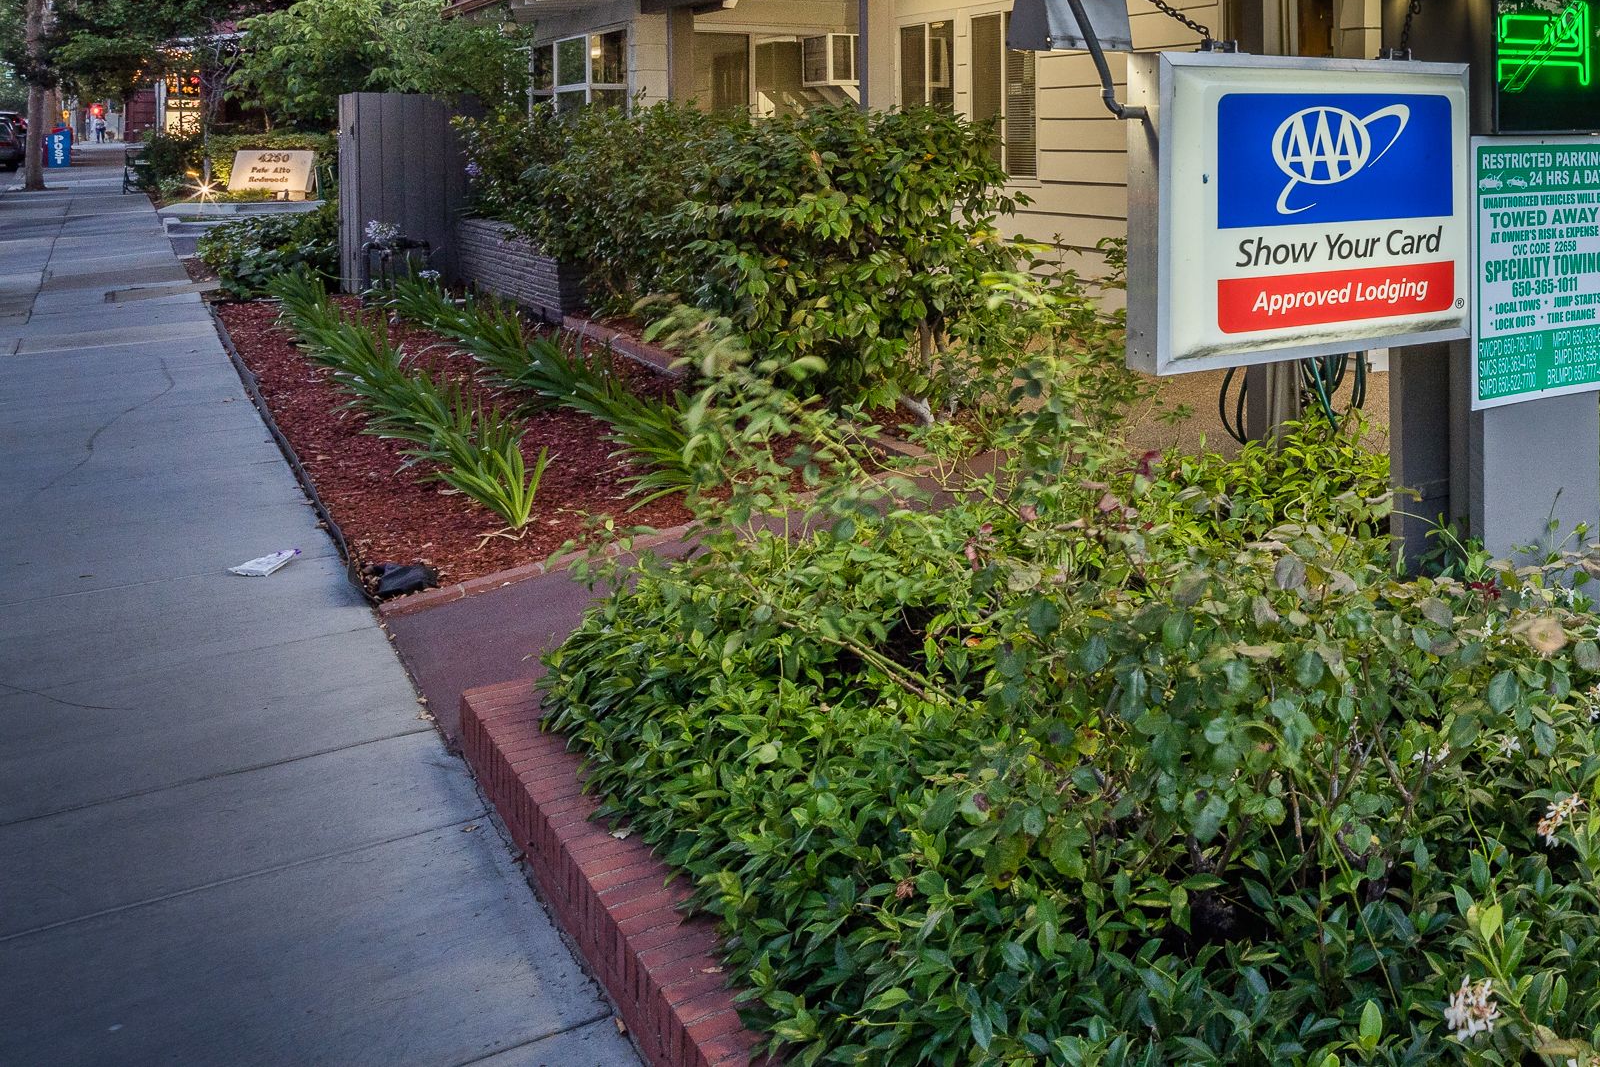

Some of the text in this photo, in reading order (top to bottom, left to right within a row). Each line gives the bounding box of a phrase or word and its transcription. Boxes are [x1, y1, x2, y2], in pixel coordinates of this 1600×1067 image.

[53, 134, 65, 164] POST
[1284, 109, 1361, 180] AAA
[1482, 152, 1553, 169] RESTRICTED
[1529, 171, 1543, 186] 24
[1546, 170, 1570, 185] HRS
[1572, 170, 1581, 184] A
[1483, 195, 1539, 209] UNAUTHORIZED
[1540, 193, 1575, 206] VEHICLES
[1577, 192, 1596, 204] WILL
[1490, 207, 1599, 229] TOWED AWAY
[1490, 225, 1599, 244] AT OWNER'S RISK & EXPENSE
[1235, 225, 1443, 268] Show Your Card
[1512, 240, 1577, 256] CVC CODE 22658
[1485, 256, 1550, 283] SPECIALTY
[1252, 277, 1429, 315] Approved Lodging
[1512, 276, 1578, 297] 650-365-1011
[1495, 301, 1517, 315] LOCAL
[1518, 299, 1541, 313] TOWS
[1554, 295, 1574, 308] JUMP
[1495, 308, 1596, 330] LOCK OUTS TIRE CHANGE
[1479, 340, 1503, 358] RWCPD
[1555, 348, 1572, 365] BMPD
[1479, 378, 1497, 396] SMPD
